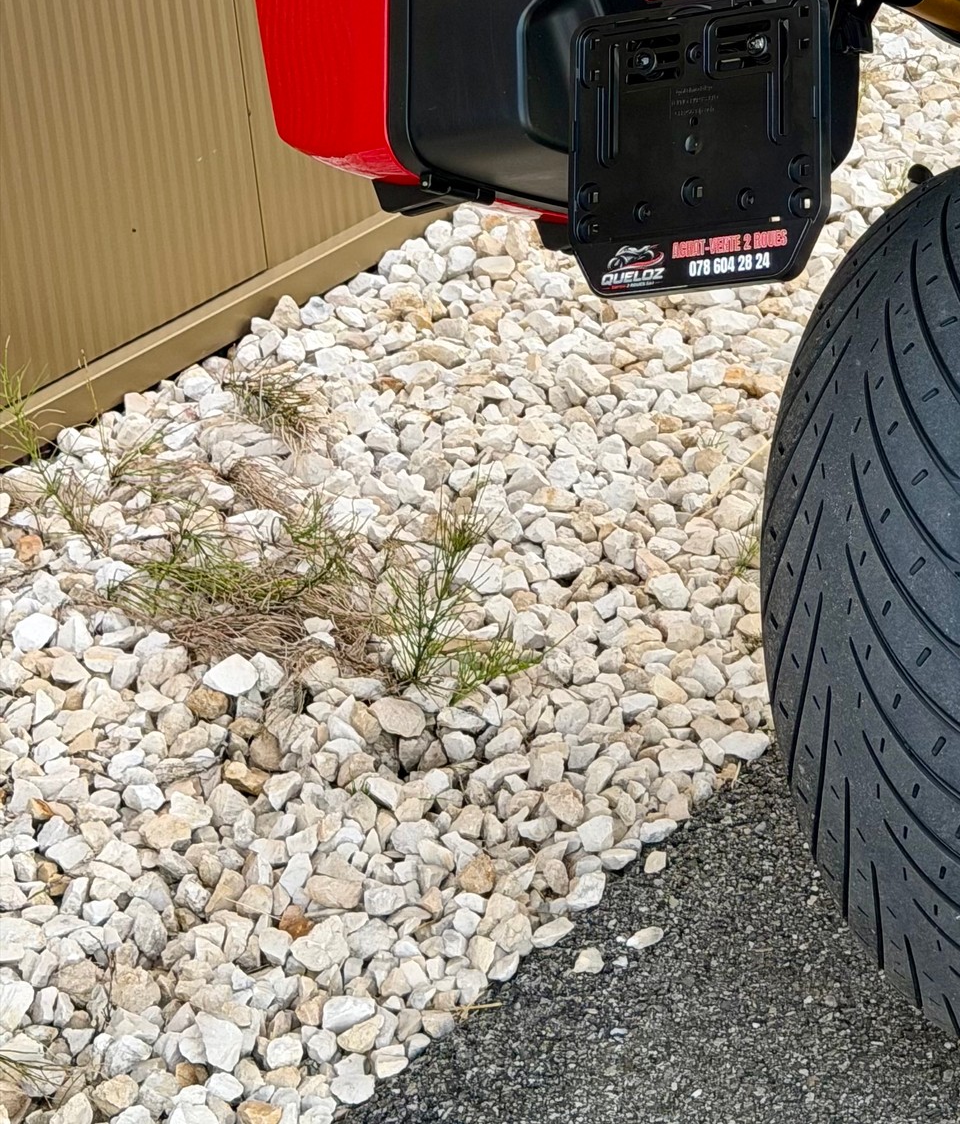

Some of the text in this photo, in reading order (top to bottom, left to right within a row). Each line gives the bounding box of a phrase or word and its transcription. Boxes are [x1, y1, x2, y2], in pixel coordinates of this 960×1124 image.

[671, 229, 788, 259] ACHAT-VENTE 2 ROUES
[600, 267, 666, 286] QUELOZ
[688, 252, 770, 277] 078 604 28 24
